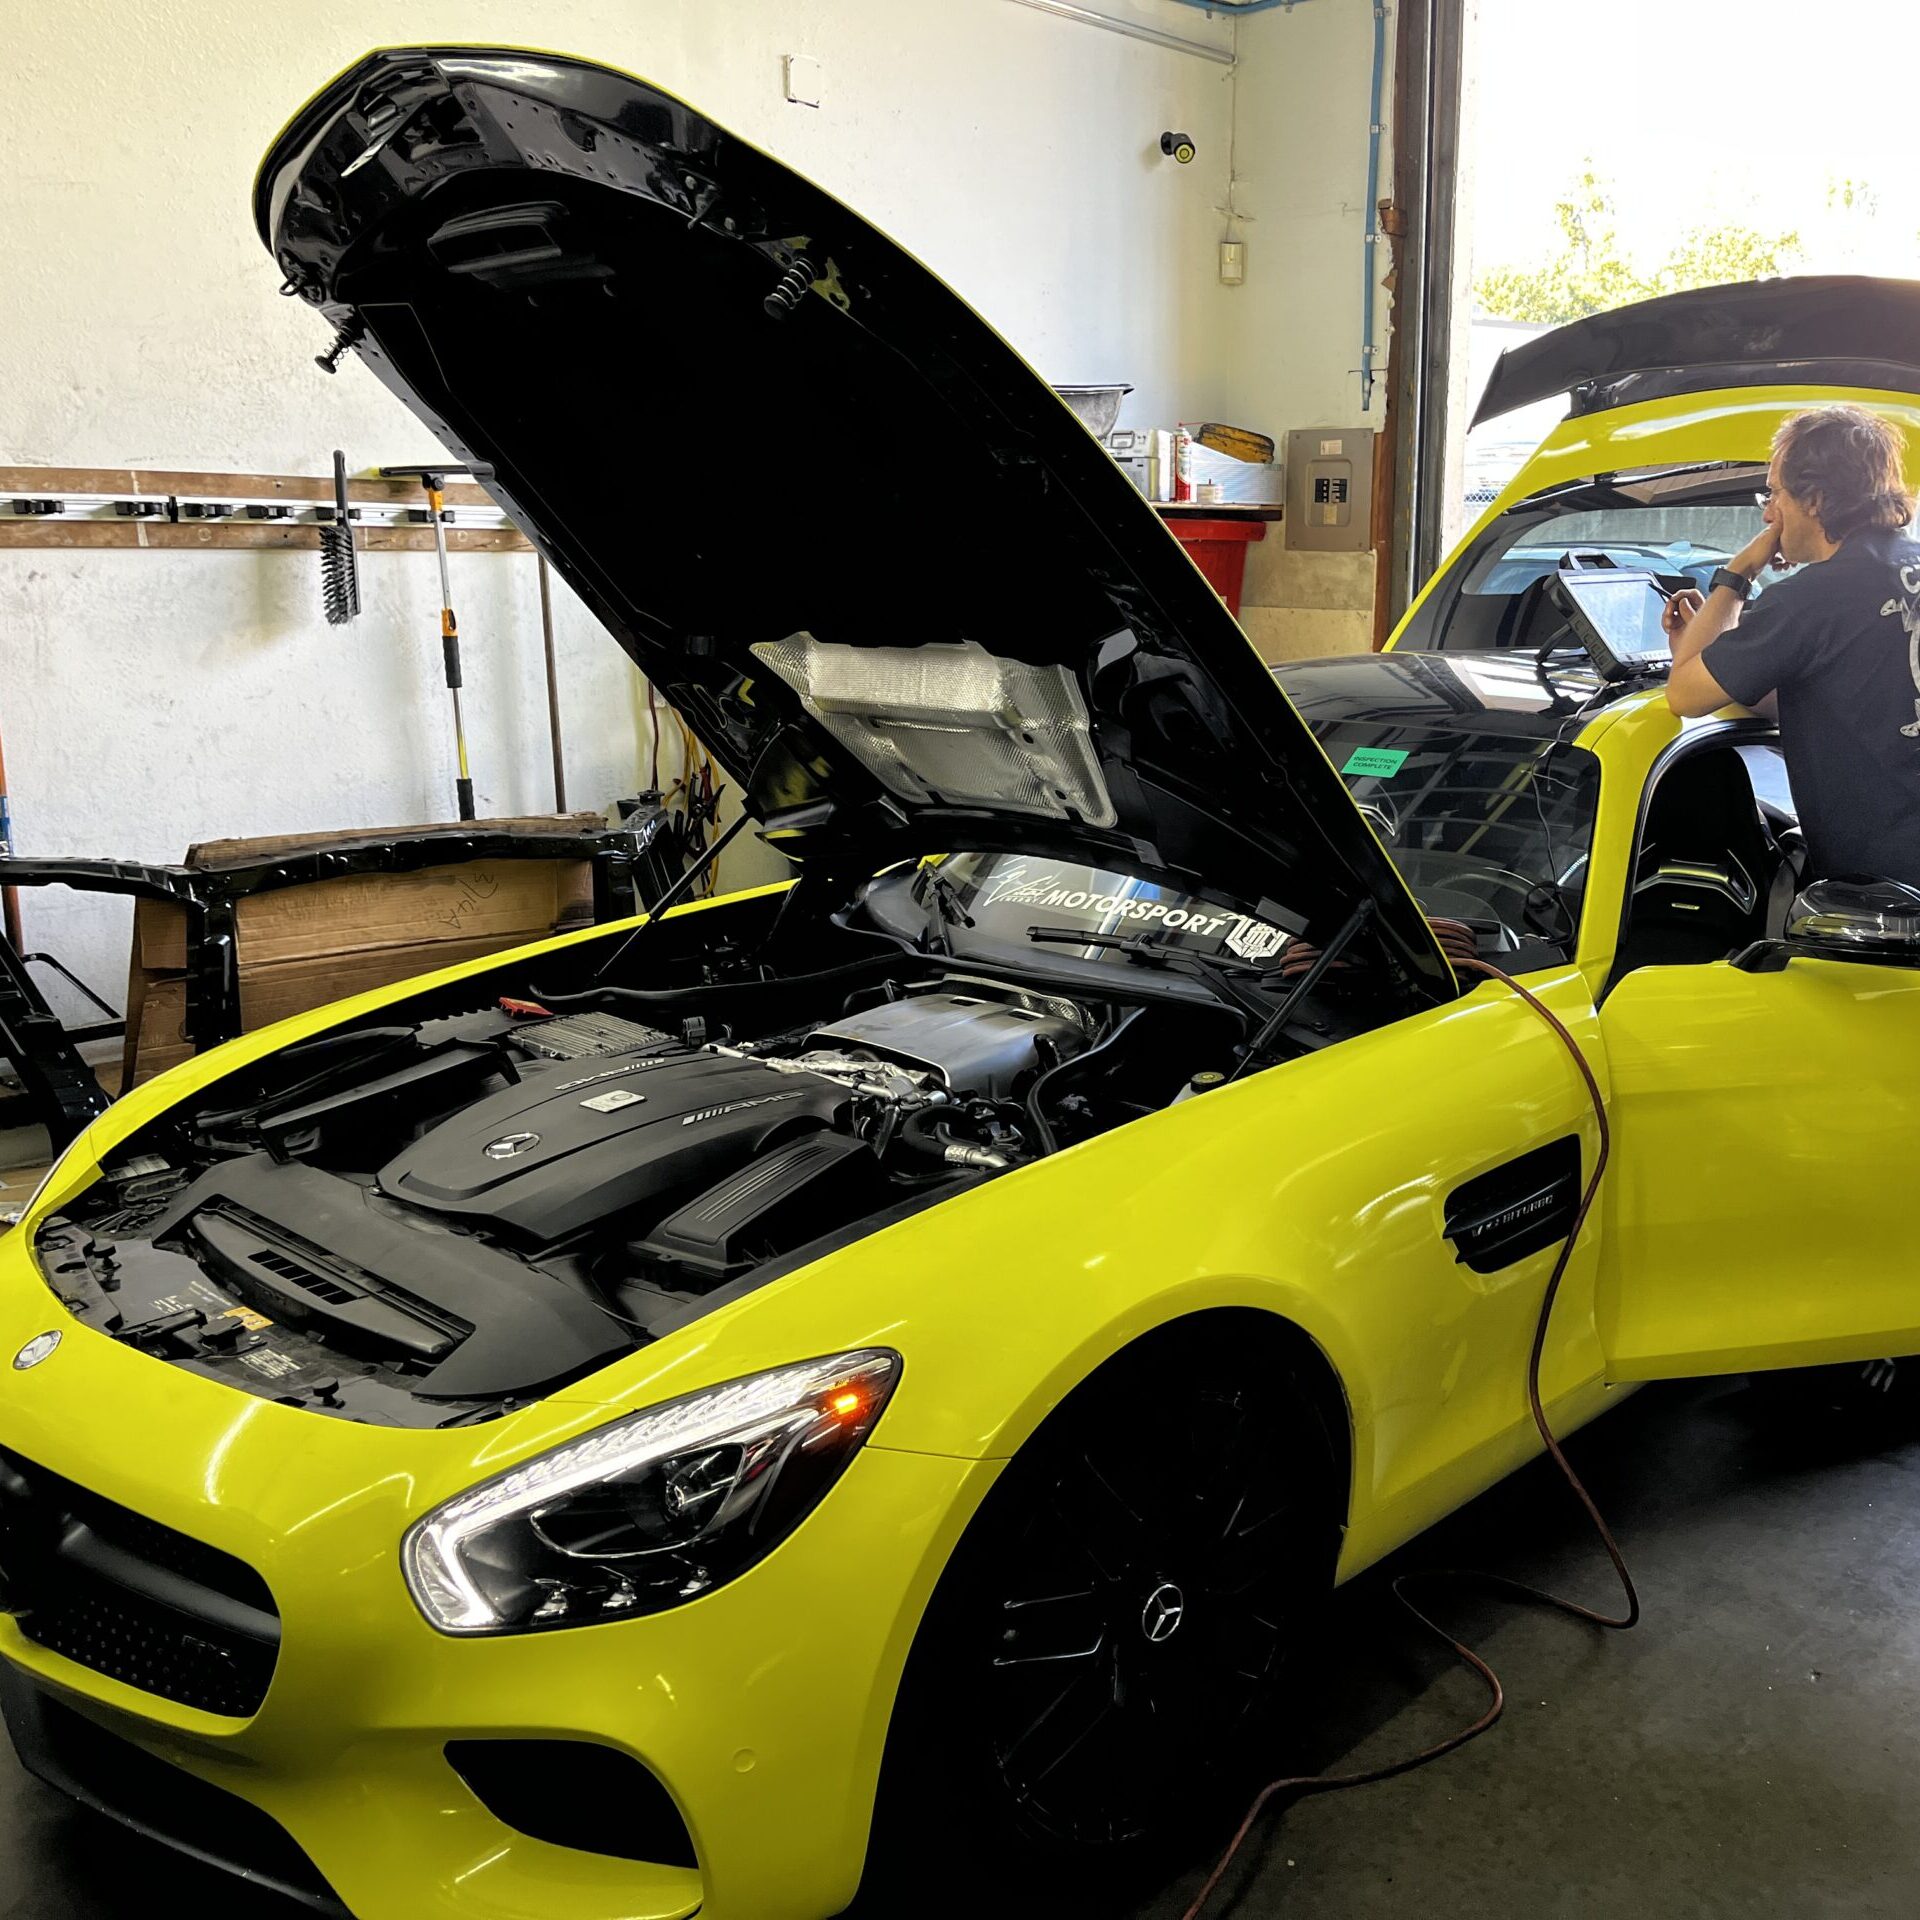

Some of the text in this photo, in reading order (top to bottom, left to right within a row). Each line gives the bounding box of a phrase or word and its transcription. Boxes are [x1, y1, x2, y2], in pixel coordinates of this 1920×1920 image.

[1353, 756, 1398, 764] INSPECTION
[1352, 762, 1392, 770] COMPLETE
[1039, 888, 1228, 937] MOTORSPORT
